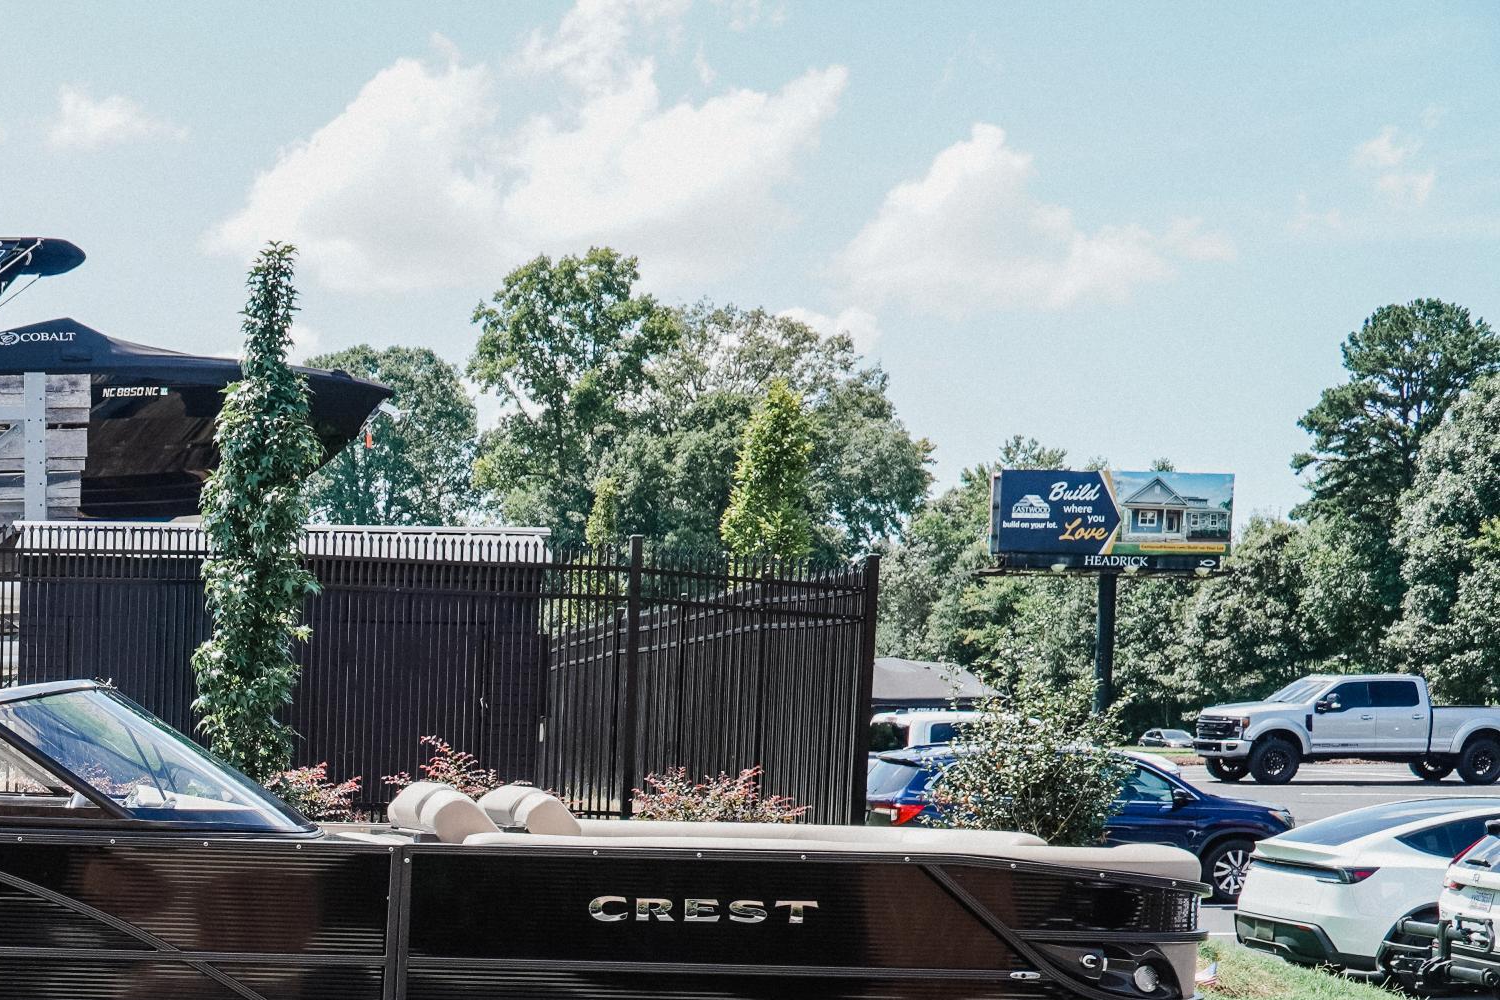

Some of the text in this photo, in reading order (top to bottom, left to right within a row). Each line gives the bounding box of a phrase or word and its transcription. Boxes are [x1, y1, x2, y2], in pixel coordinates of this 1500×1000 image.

[20, 332, 76, 342] COBALT
[102, 387, 116, 397] NC
[145, 386, 159, 396] NC
[1049, 481, 1101, 501] Build
[1063, 503, 1093, 513] where
[1002, 520, 1020, 528] build
[1030, 521, 1046, 529] your
[1046, 520, 1058, 529] lot.
[1087, 515, 1105, 524] you
[1058, 517, 1109, 541] Love
[1084, 555, 1149, 567] HEADRICK
[588, 895, 820, 924] CREST
